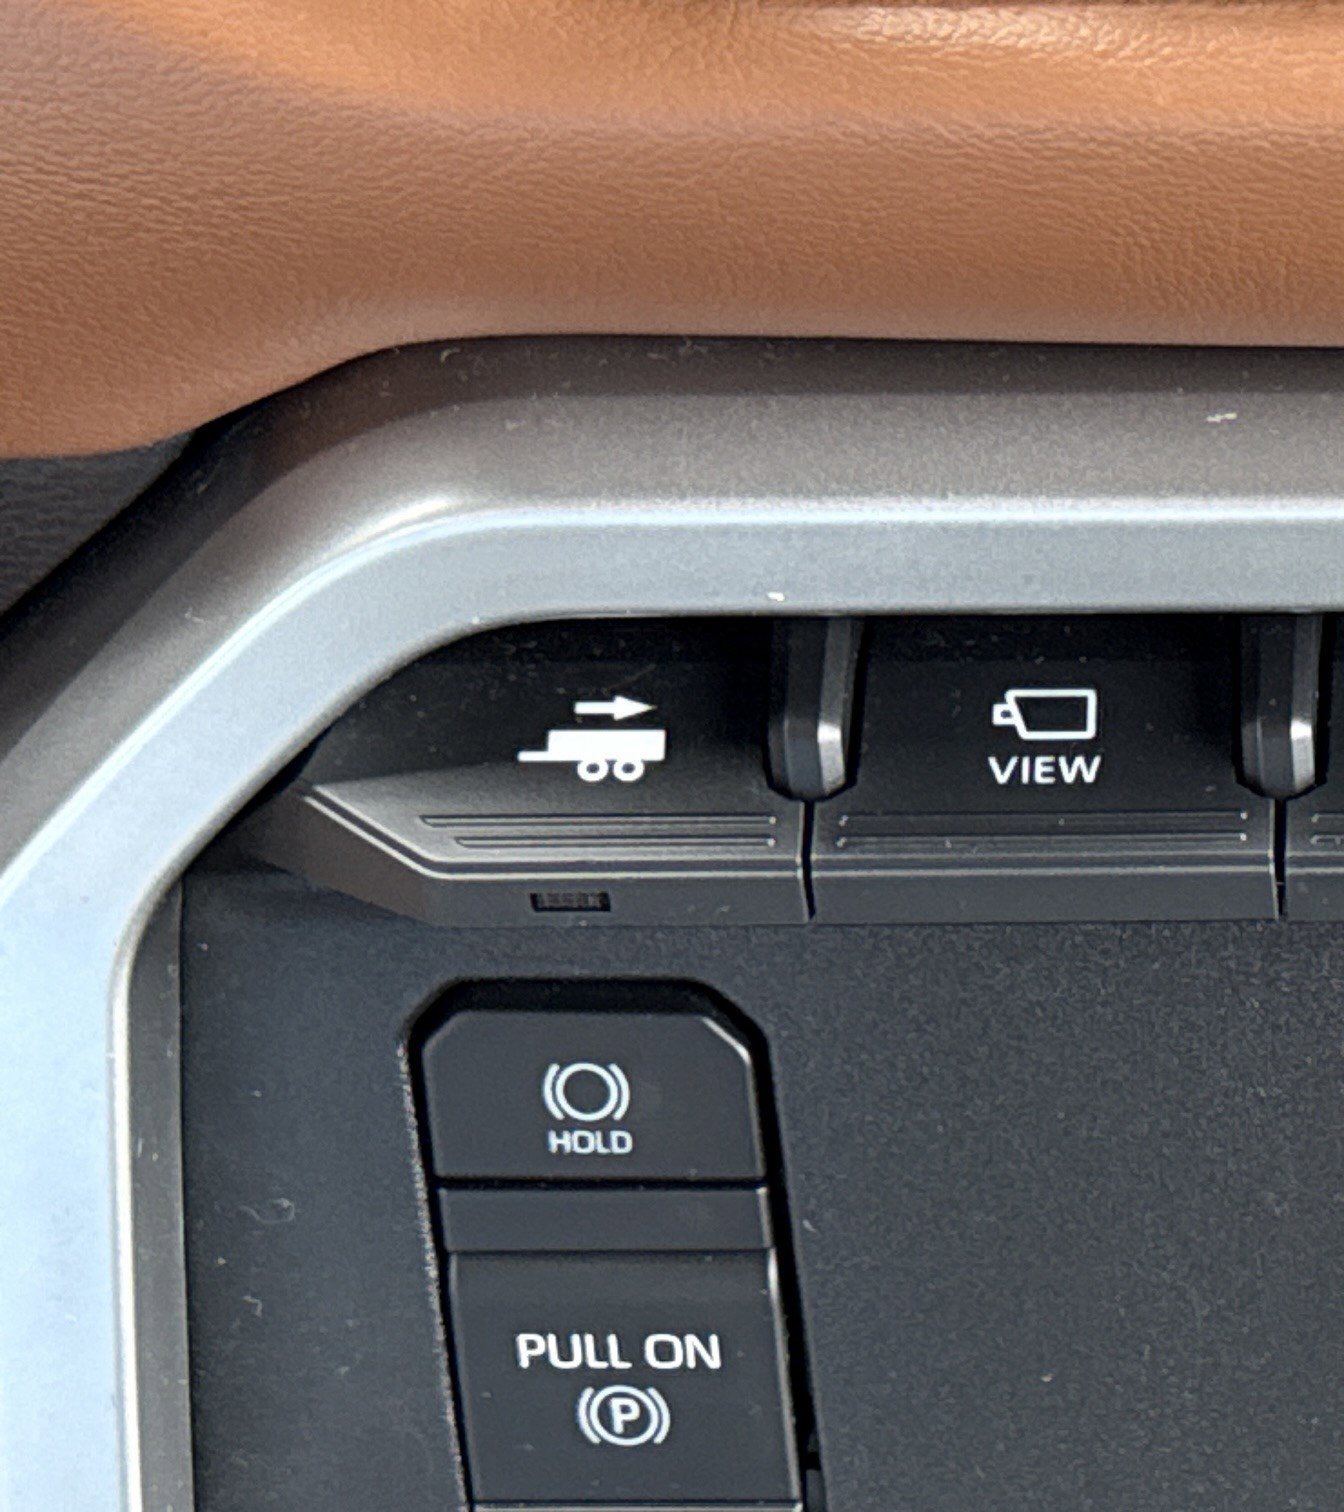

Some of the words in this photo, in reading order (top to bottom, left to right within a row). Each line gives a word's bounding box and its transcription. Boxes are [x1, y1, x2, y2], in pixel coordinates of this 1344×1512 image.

[987, 755, 1101, 785] VIEW
[548, 1130, 633, 1155] HOLD
[516, 1333, 633, 1370] PULL
[644, 1333, 722, 1370] ON
